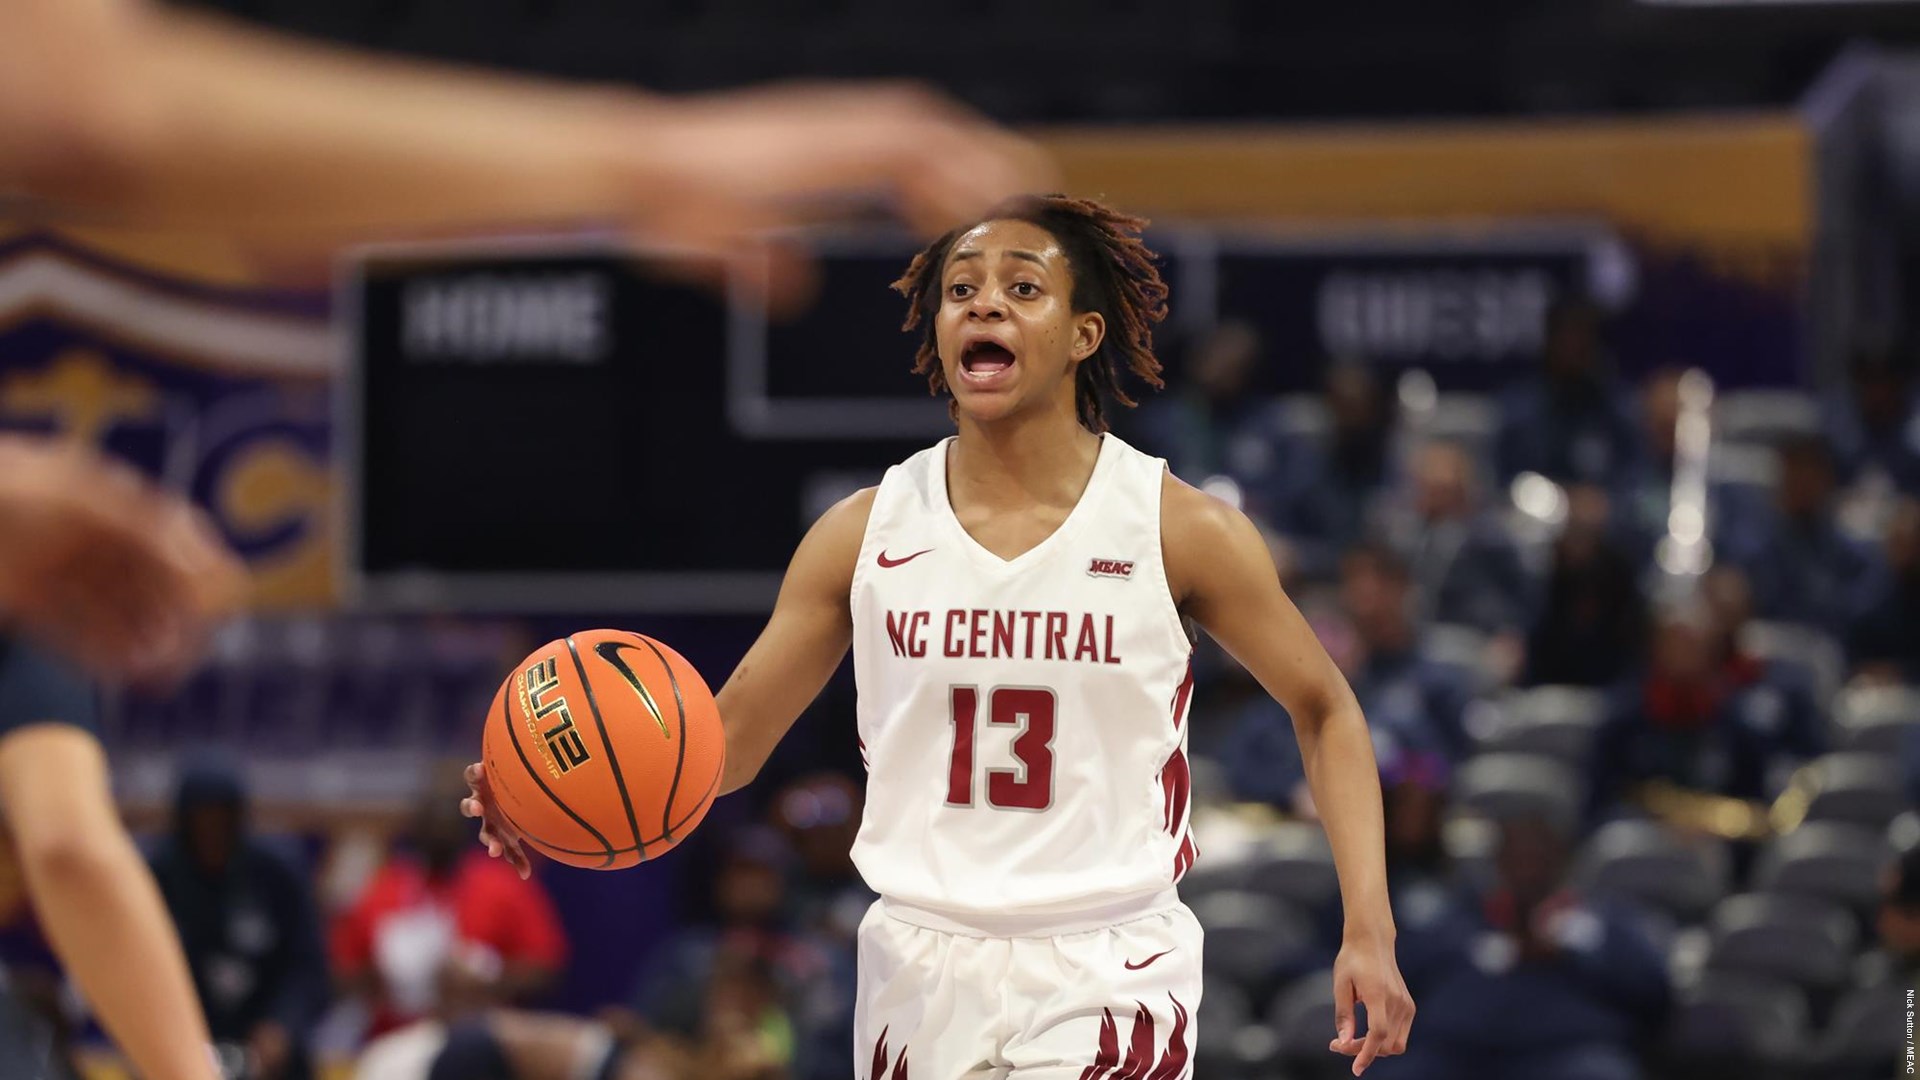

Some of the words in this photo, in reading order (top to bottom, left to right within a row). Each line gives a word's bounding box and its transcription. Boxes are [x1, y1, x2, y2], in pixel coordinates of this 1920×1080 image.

[402, 272, 608, 361] HOME
[1090, 559, 1133, 575] MEAC
[886, 609, 930, 658] NC
[943, 609, 1121, 664] CENTRAL
[943, 683, 1059, 813] 13
